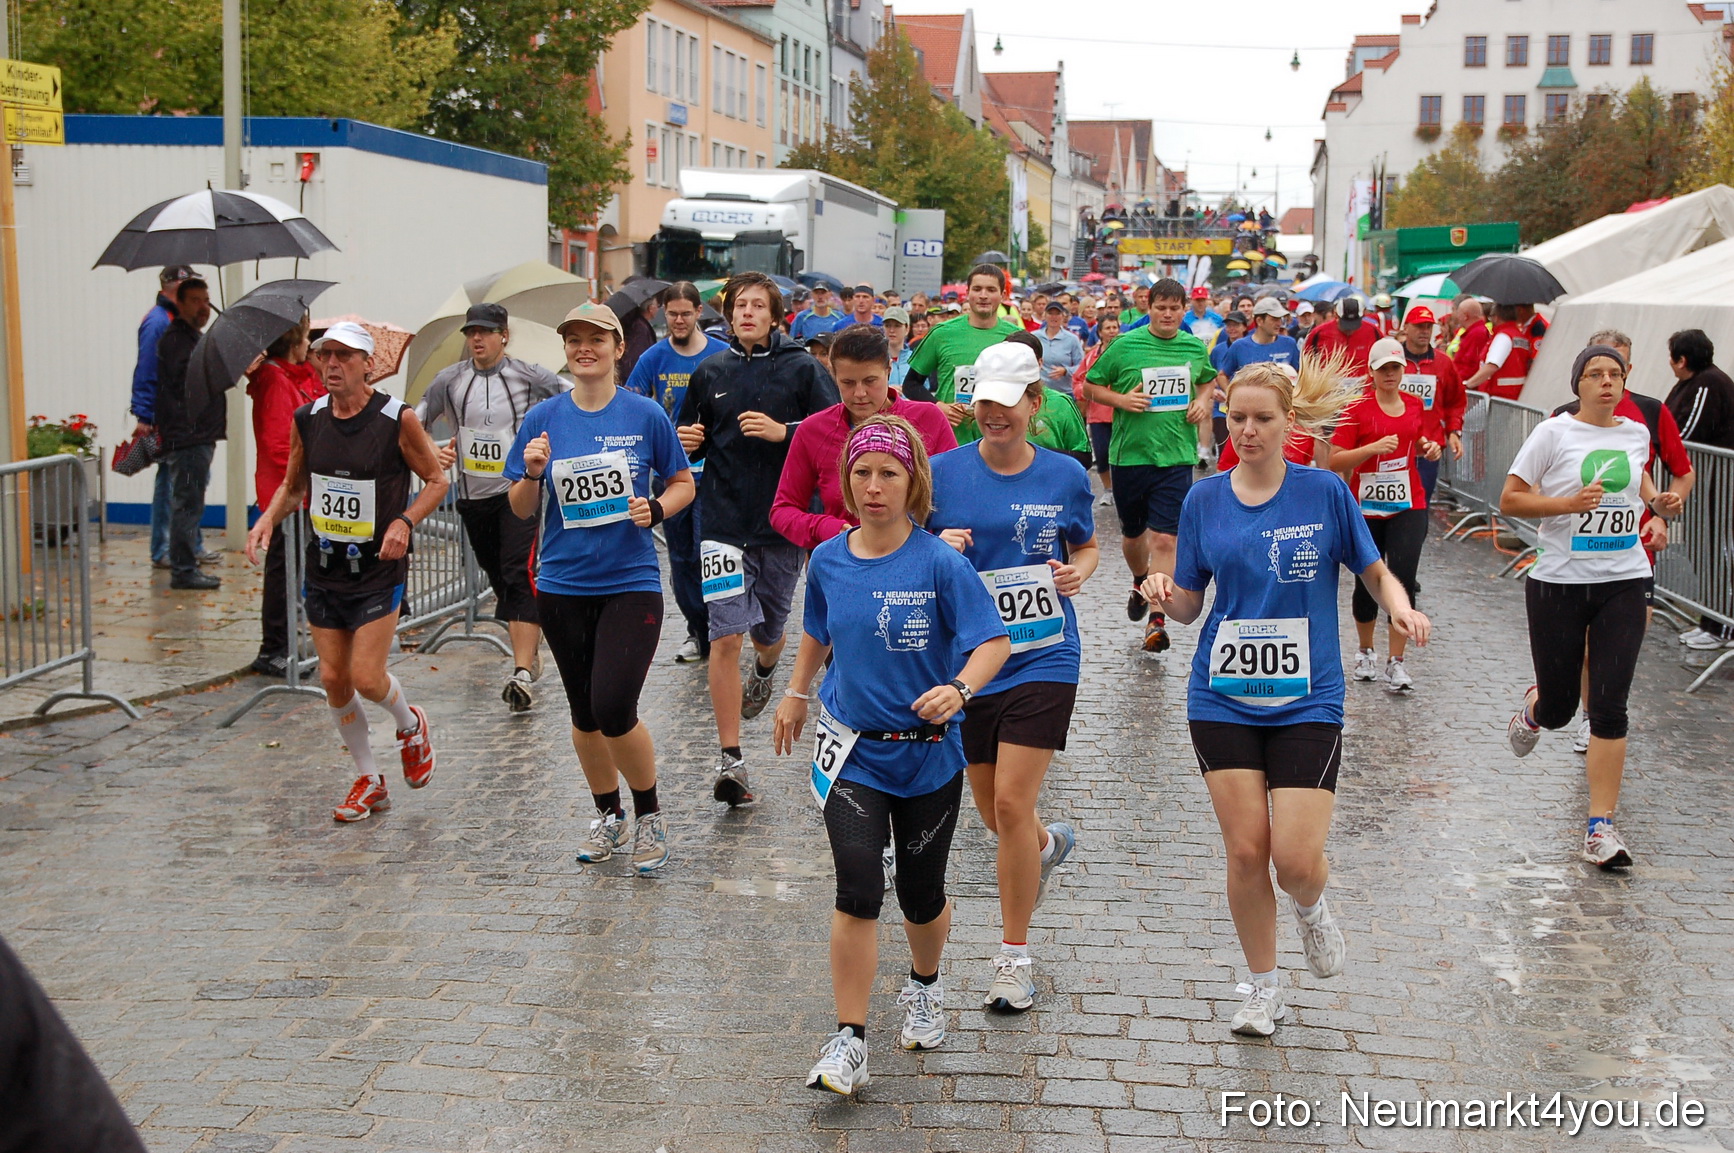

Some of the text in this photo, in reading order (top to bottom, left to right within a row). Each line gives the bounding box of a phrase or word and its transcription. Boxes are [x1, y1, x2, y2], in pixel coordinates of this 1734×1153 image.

[6, 64, 43, 82] Kinder-
[692, 210, 753, 224] BOCK
[1154, 242, 1193, 252] START
[1148, 378, 1186, 395] 2775
[470, 442, 501, 460] 440
[572, 458, 602, 470] BOCK
[561, 470, 625, 503] 2853
[1365, 484, 1406, 501] 2663
[321, 493, 361, 520] 349
[578, 503, 615, 517] Daniela
[1010, 503, 1064, 512] 12. NEUMARKTER
[1021, 510, 1057, 518] STADTLAUF
[325, 521, 352, 534] Lothar
[1579, 510, 1635, 534] 2780
[1261, 523, 1324, 538] 12. NEUMARKTER
[1272, 530, 1314, 542] STADTLAUF
[1587, 539, 1625, 549] Cornelia
[994, 571, 1029, 584] BOCK
[872, 591, 936, 599] 12. NEUMARKTER
[883, 598, 927, 606] STADTLAUF
[991, 587, 1053, 622] 926
[1239, 625, 1278, 634] BOCK
[1220, 643, 1300, 675] 2905
[1243, 682, 1274, 695] Julia
[907, 804, 953, 855] Salomon
